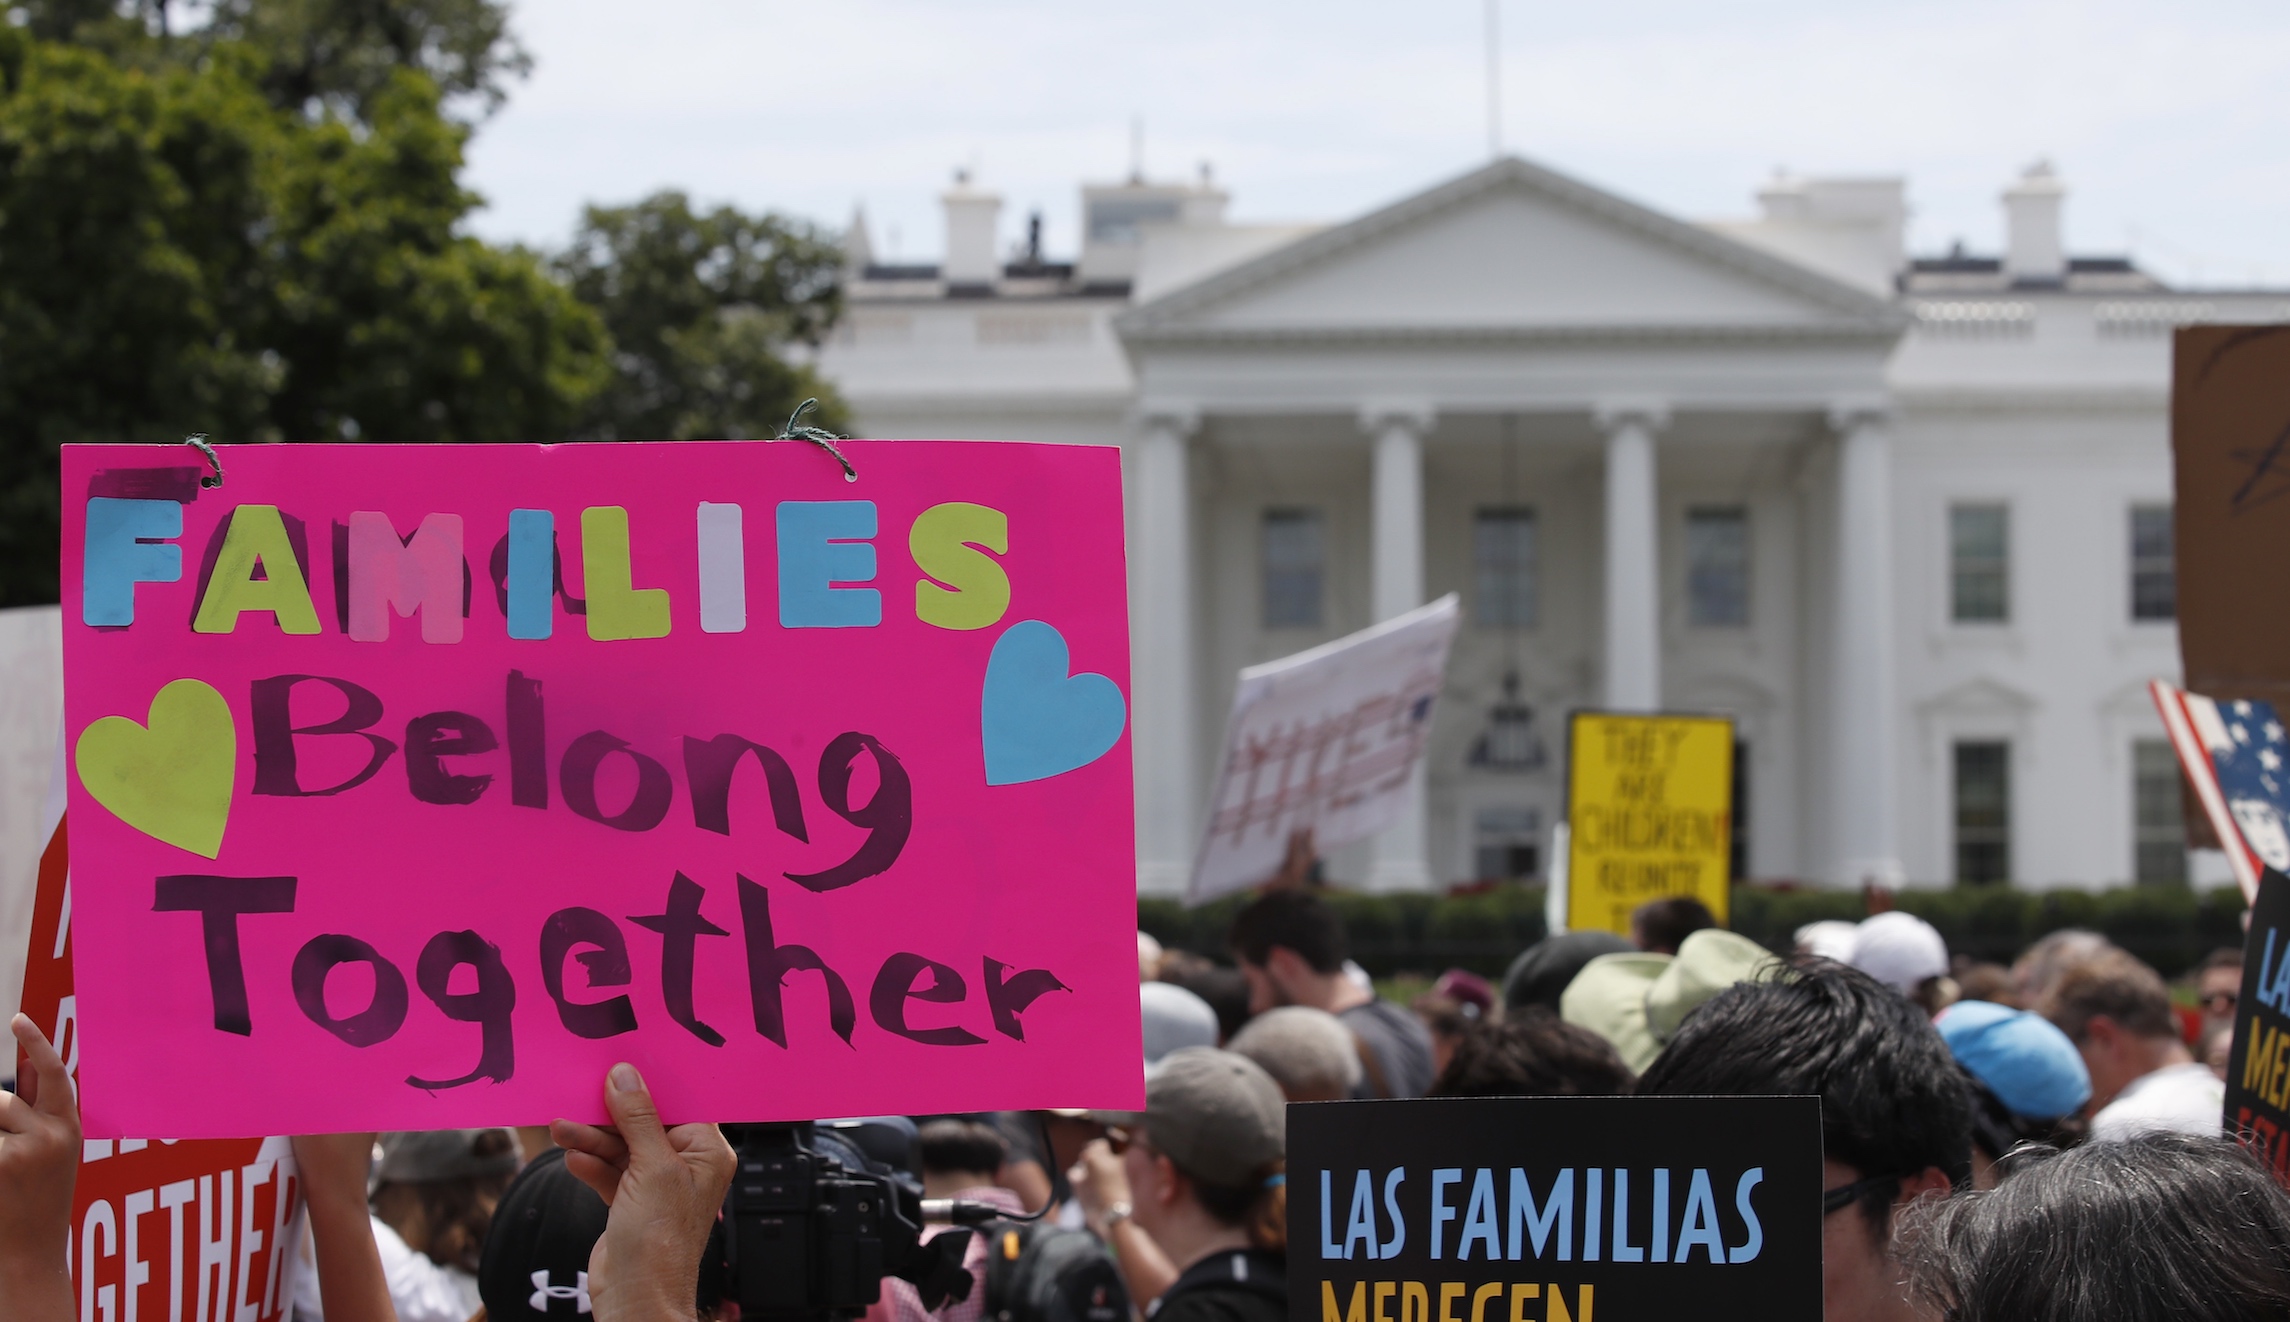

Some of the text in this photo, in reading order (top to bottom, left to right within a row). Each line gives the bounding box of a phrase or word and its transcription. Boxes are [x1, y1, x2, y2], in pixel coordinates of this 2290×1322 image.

[83, 497, 1011, 644] FAMILIES
[251, 669, 912, 893] Belong
[151, 870, 1073, 1092] Together
[2255, 926, 2290, 1018] LA
[2242, 1015, 2290, 1112] ME
[66, 1154, 301, 1322] GETHER
[1321, 1166, 1763, 1264] LAS FAMILIAS
